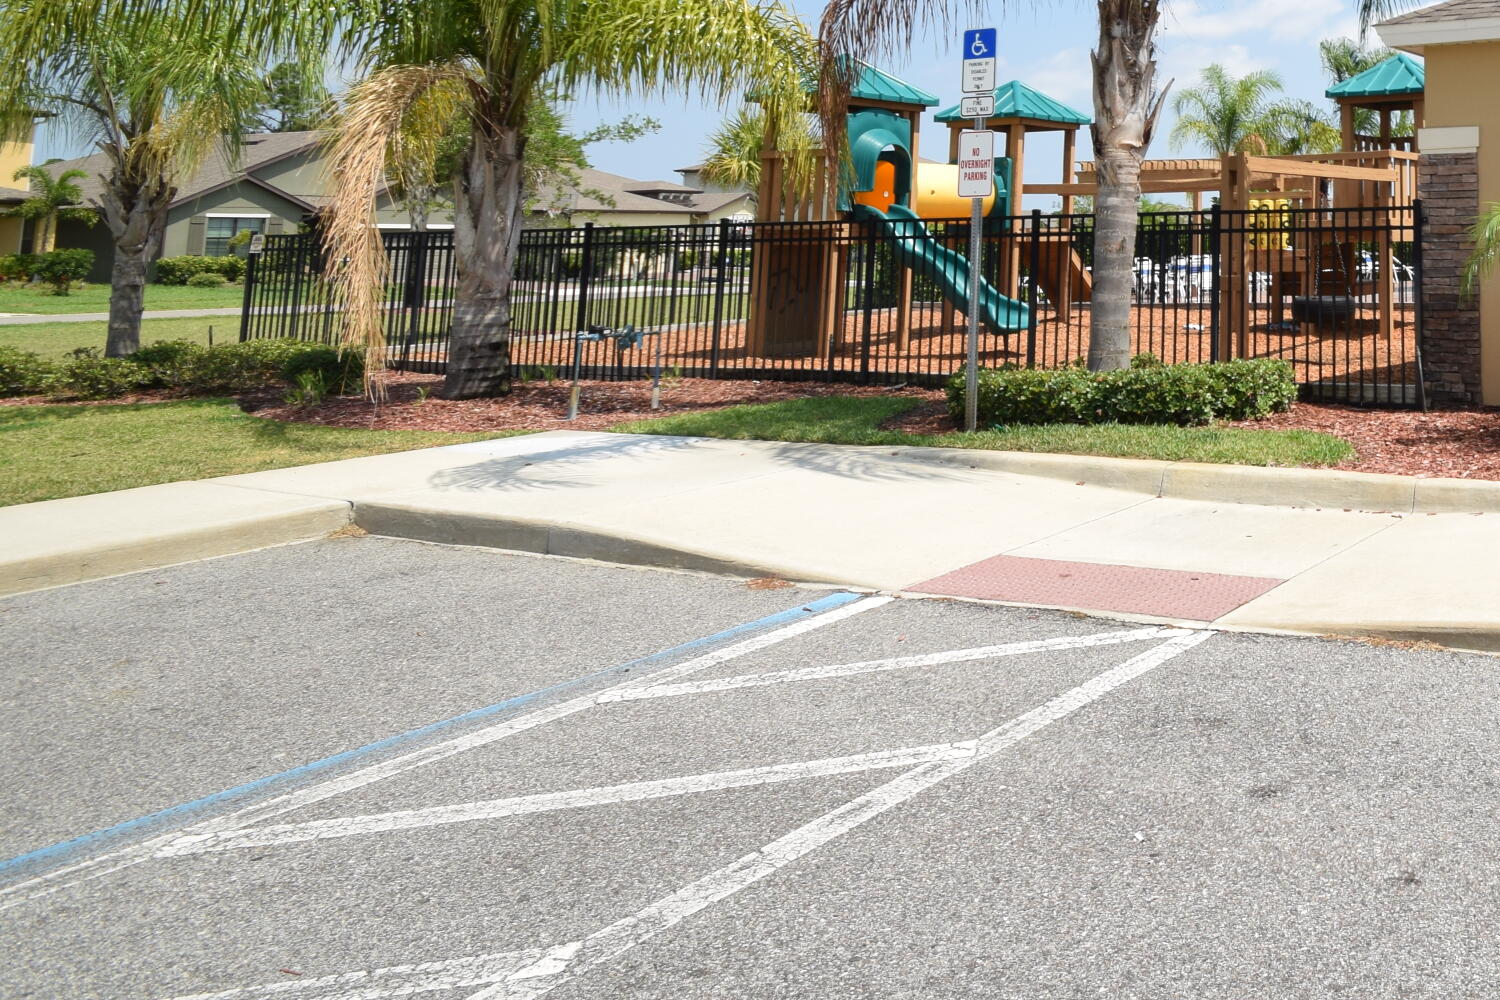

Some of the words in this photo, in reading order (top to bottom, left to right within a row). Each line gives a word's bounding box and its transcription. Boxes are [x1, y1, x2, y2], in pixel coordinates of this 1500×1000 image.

[972, 147, 980, 157] NO
[960, 159, 991, 169] OVERNIGHT
[963, 171, 987, 180] PARKING
